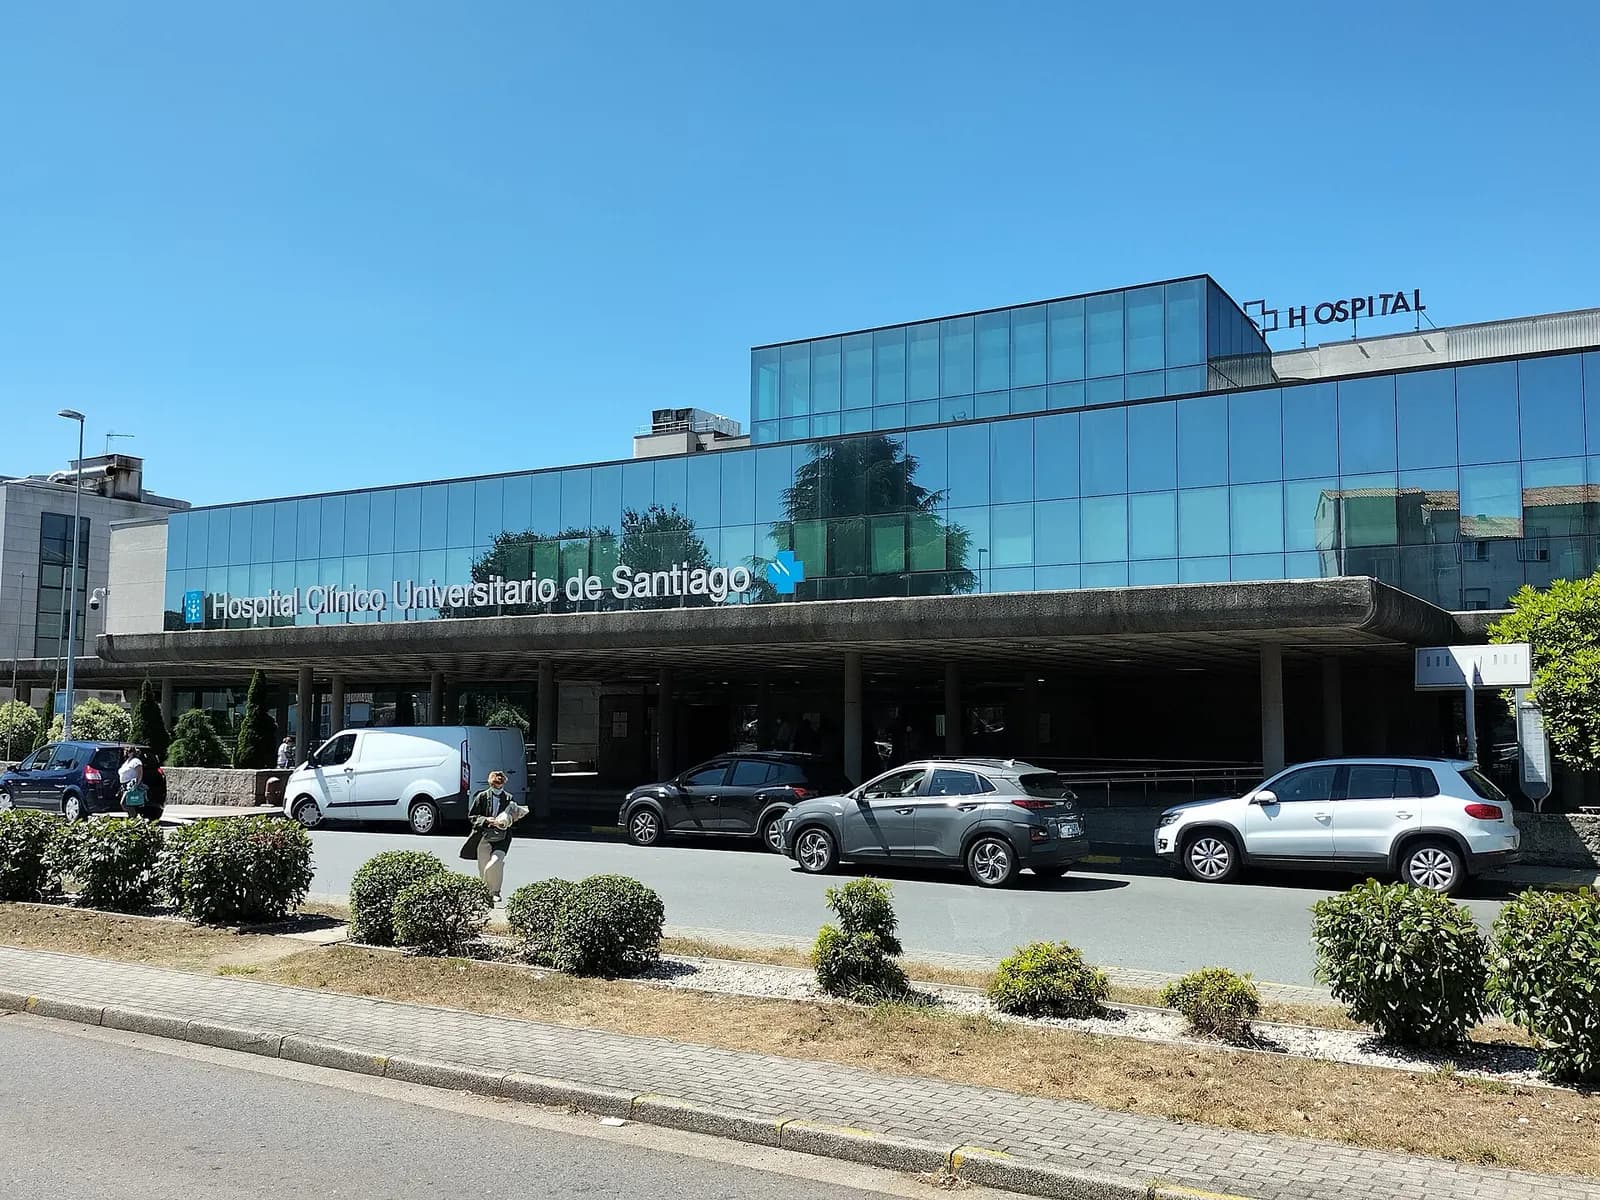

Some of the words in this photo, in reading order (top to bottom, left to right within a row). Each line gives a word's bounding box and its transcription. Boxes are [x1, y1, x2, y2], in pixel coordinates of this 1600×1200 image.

[1288, 289, 1426, 328] HOSPITAL
[212, 588, 300, 624] Hospital
[306, 584, 386, 614] Clínico
[393, 573, 556, 609] Universitario
[566, 569, 602, 600] de
[612, 563, 751, 602] Santiago
